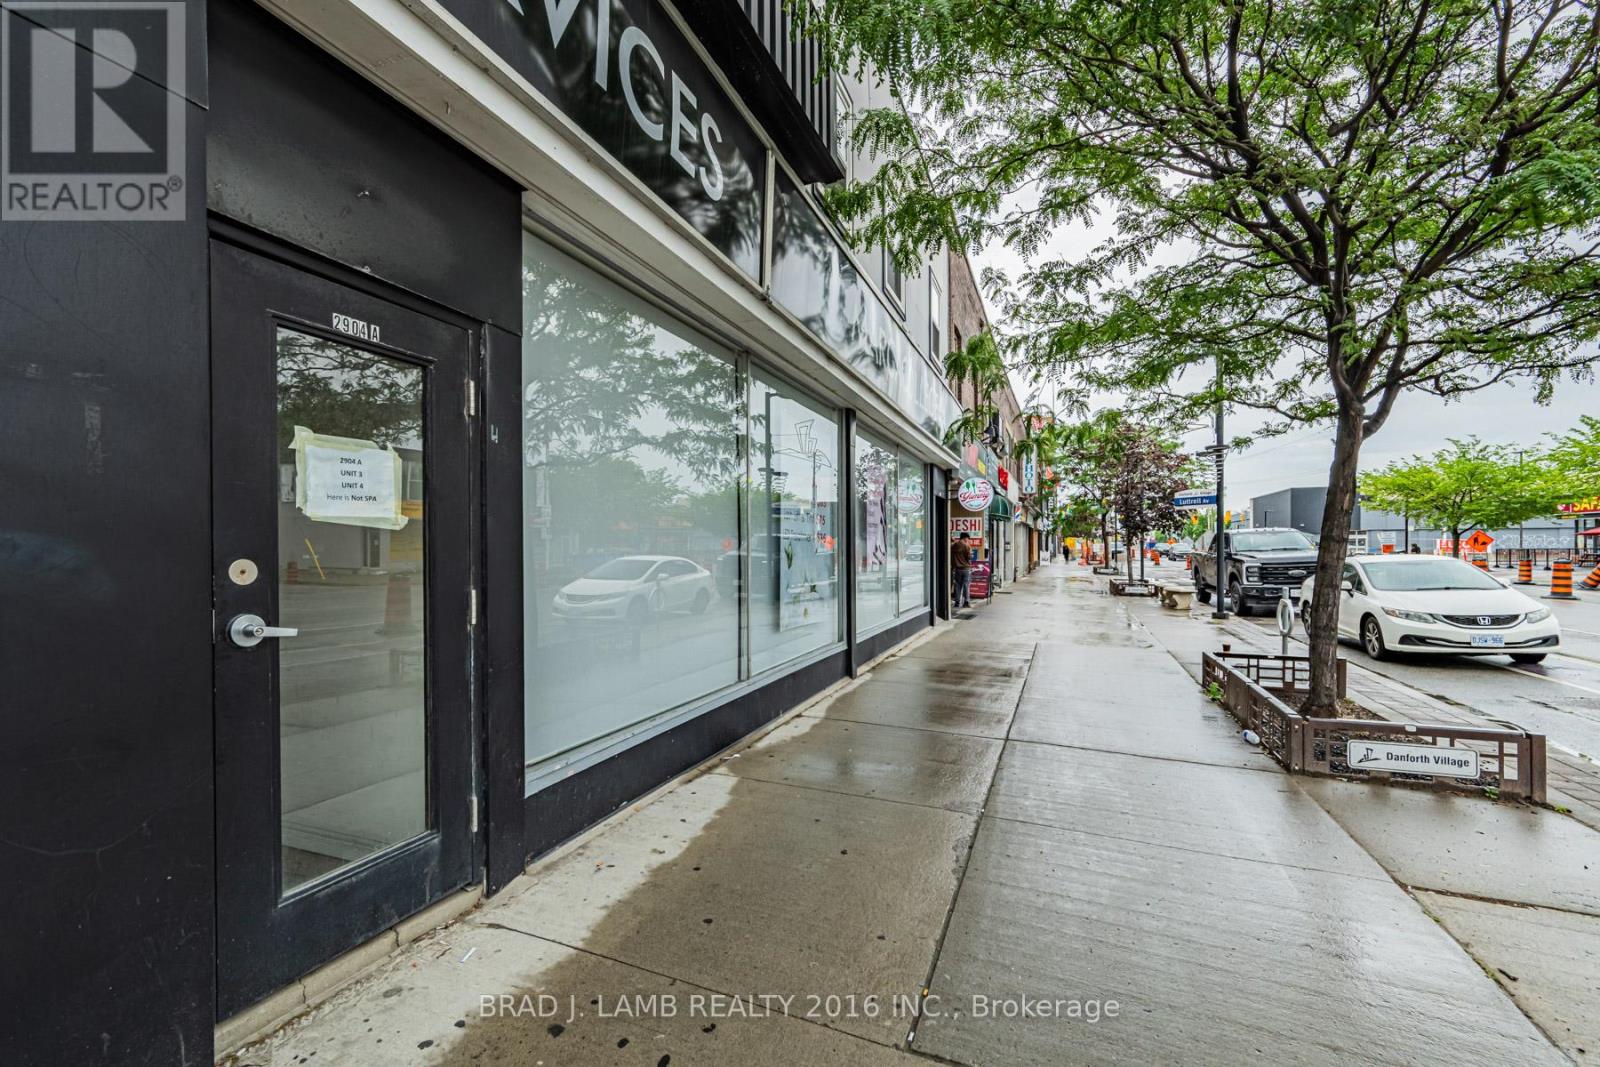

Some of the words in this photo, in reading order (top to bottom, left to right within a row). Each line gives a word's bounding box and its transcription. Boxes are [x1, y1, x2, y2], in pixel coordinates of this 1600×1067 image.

[506, 0, 724, 201] ICES
[333, 314, 367, 339] 2904
[371, 325, 379, 341] A
[351, 494, 363, 502] Not
[1572, 496, 1600, 512] SAF
[1386, 752, 1430, 764] Danforth
[1433, 755, 1470, 768] Village
